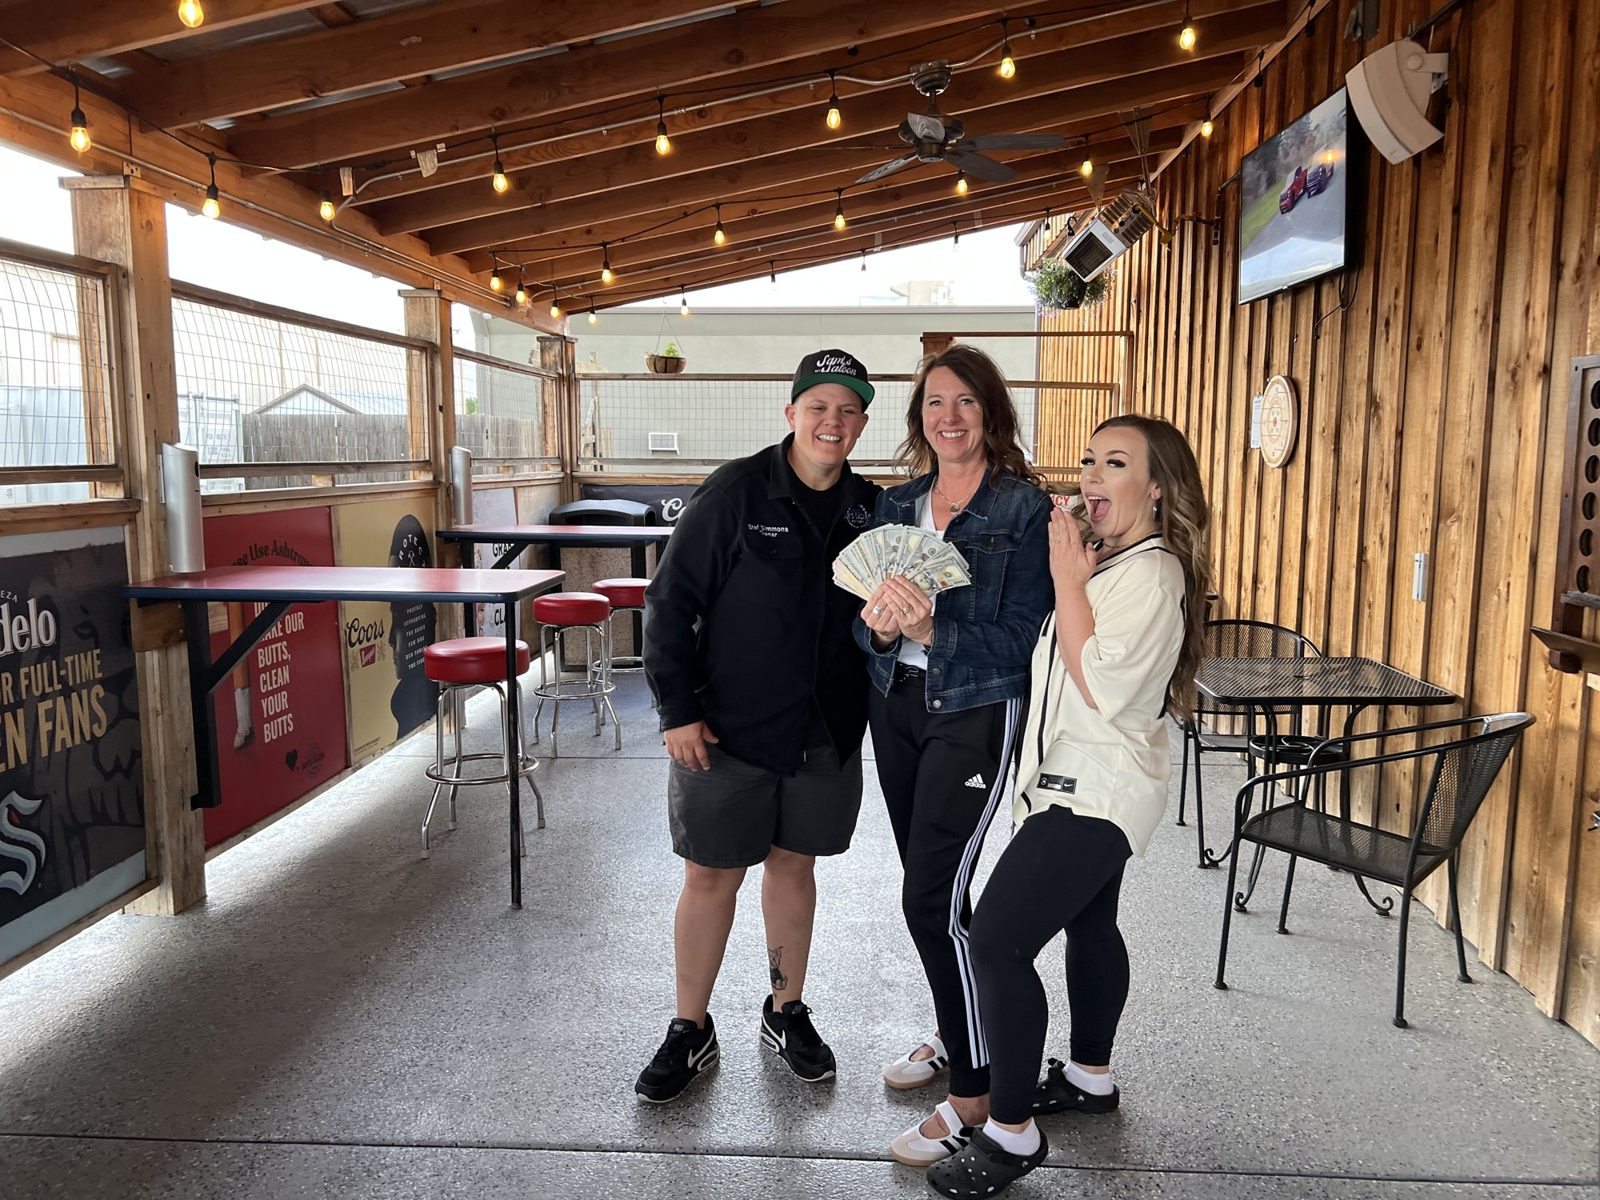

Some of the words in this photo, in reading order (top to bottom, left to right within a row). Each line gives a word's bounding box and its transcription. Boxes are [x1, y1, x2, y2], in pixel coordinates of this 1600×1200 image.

[816, 354, 852, 367] Sam's
[249, 543, 270, 561] Use
[285, 611, 305, 634] OUR
[346, 617, 385, 648] Coors
[257, 641, 291, 669] BUTTS,
[20, 648, 103, 700] FULL-TIME
[259, 665, 290, 693] CLEAN
[261, 690, 289, 718] YOUR
[37, 684, 108, 758] FANS
[263, 713, 294, 743] BUTTS
[964, 780, 987, 789] adidas
